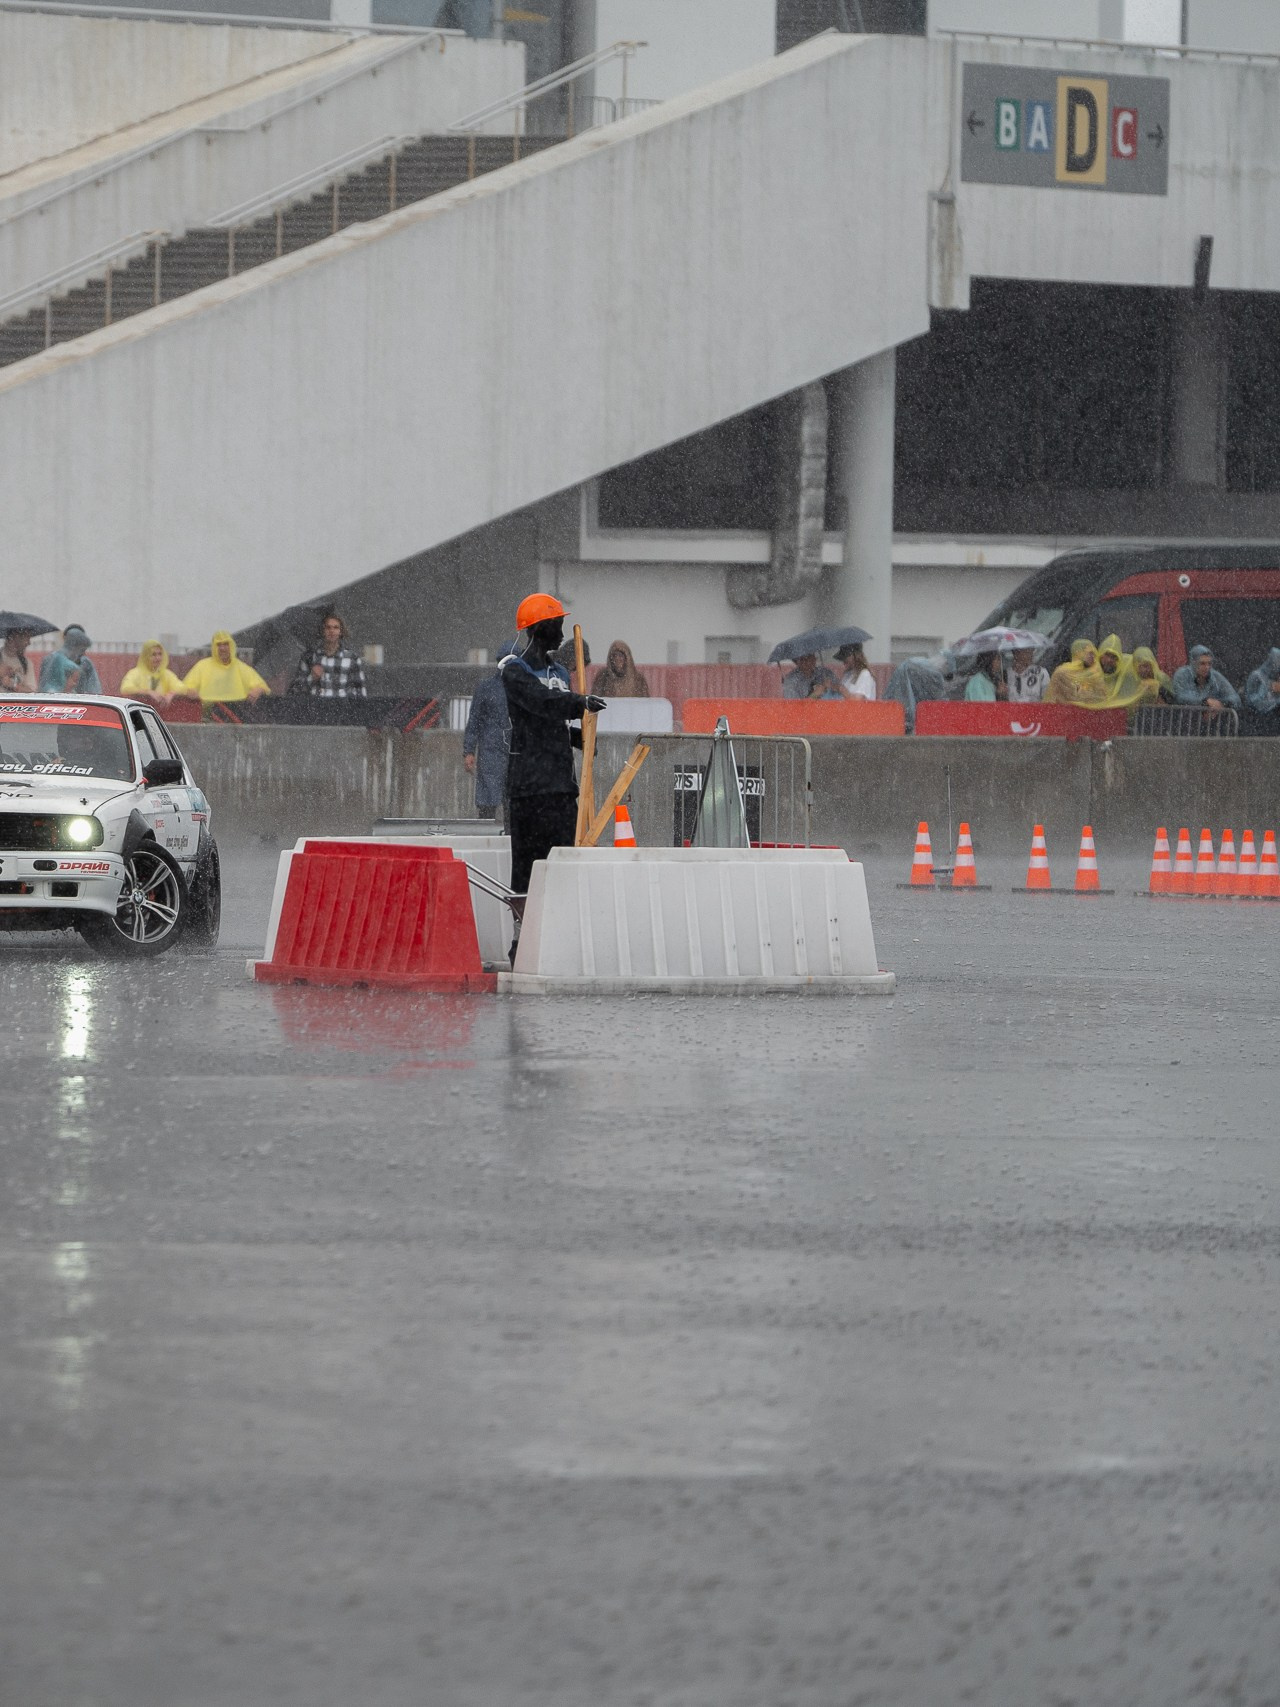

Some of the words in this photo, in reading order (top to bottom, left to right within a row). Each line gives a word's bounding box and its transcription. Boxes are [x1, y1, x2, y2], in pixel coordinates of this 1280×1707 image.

[999, 102, 1017, 147] B
[1028, 104, 1049, 149] A
[1065, 86, 1099, 173] D
[1117, 111, 1133, 156] C
